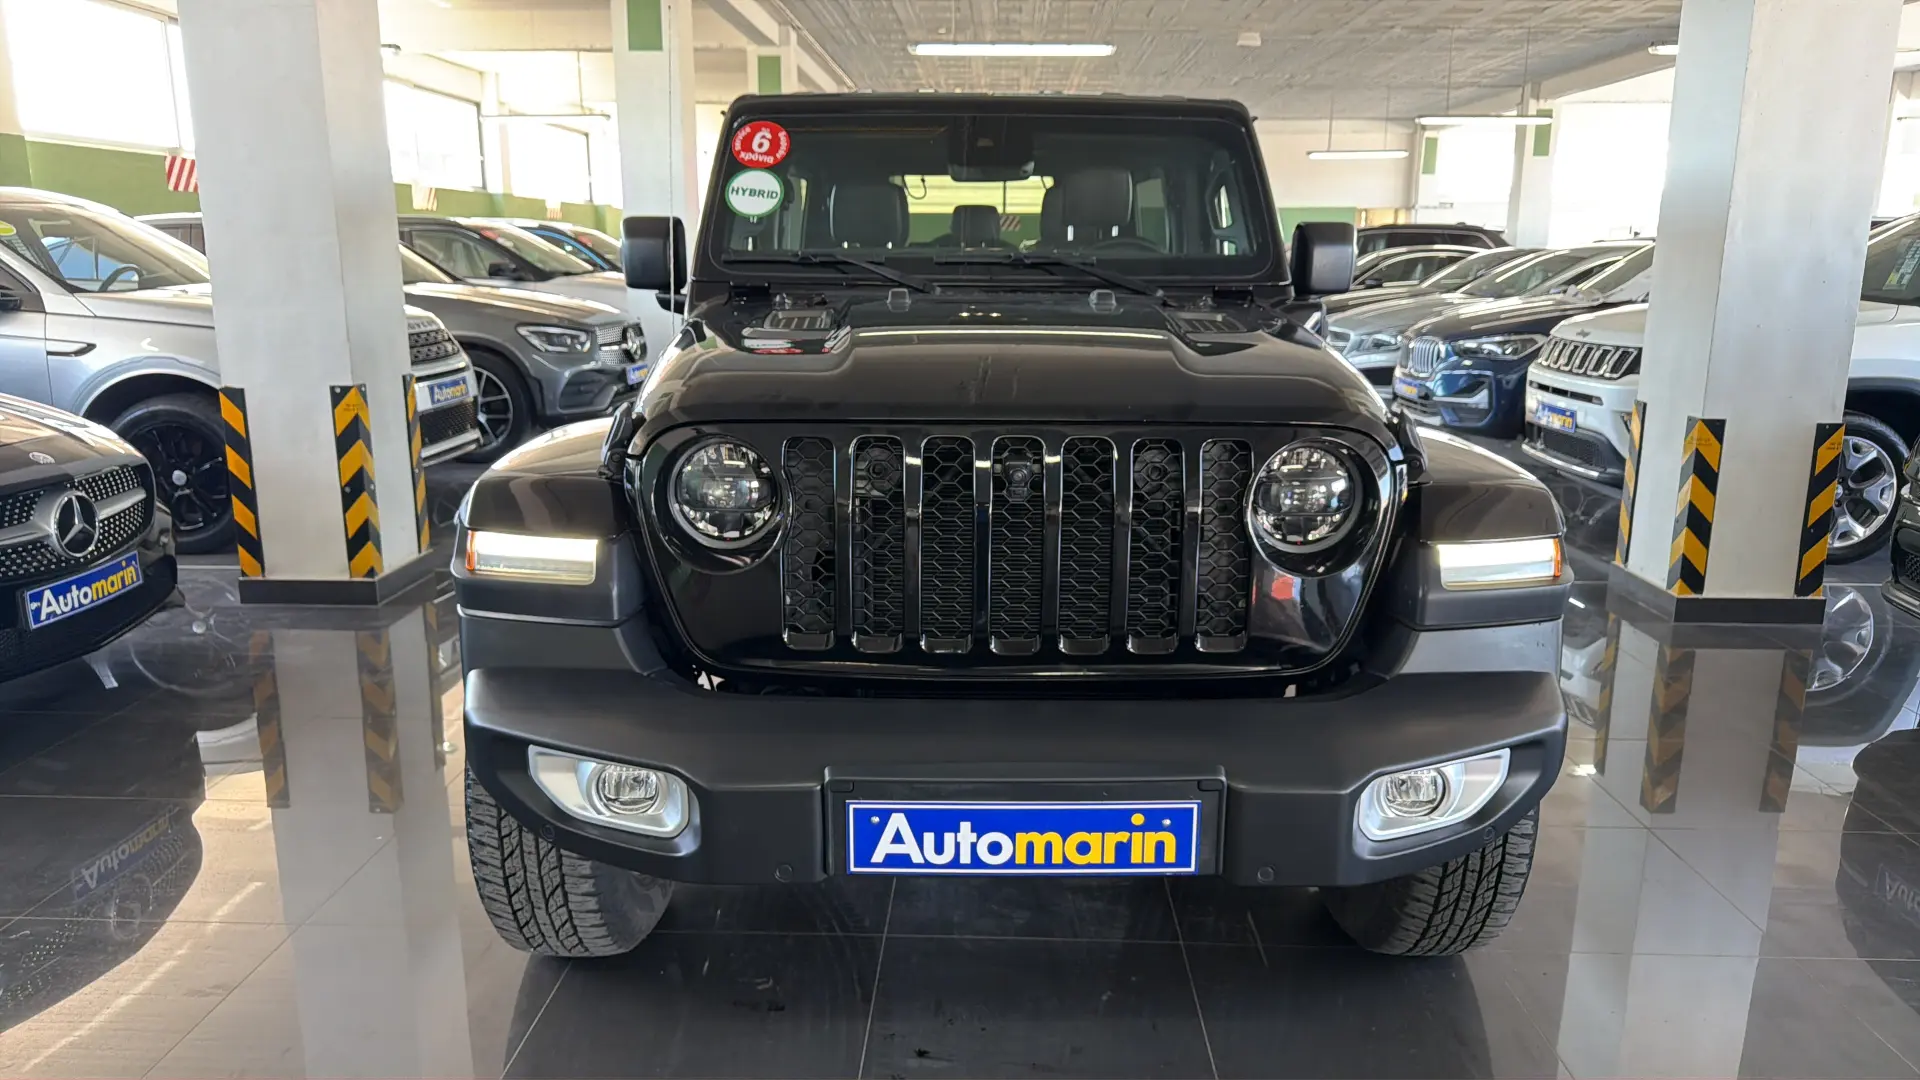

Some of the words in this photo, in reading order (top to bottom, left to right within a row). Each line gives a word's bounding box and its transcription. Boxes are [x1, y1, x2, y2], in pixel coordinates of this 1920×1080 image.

[751, 131, 772, 153] 6
[730, 186, 779, 200] HYBRID
[40, 560, 137, 621] Automarin
[870, 813, 1176, 865] Automarin
